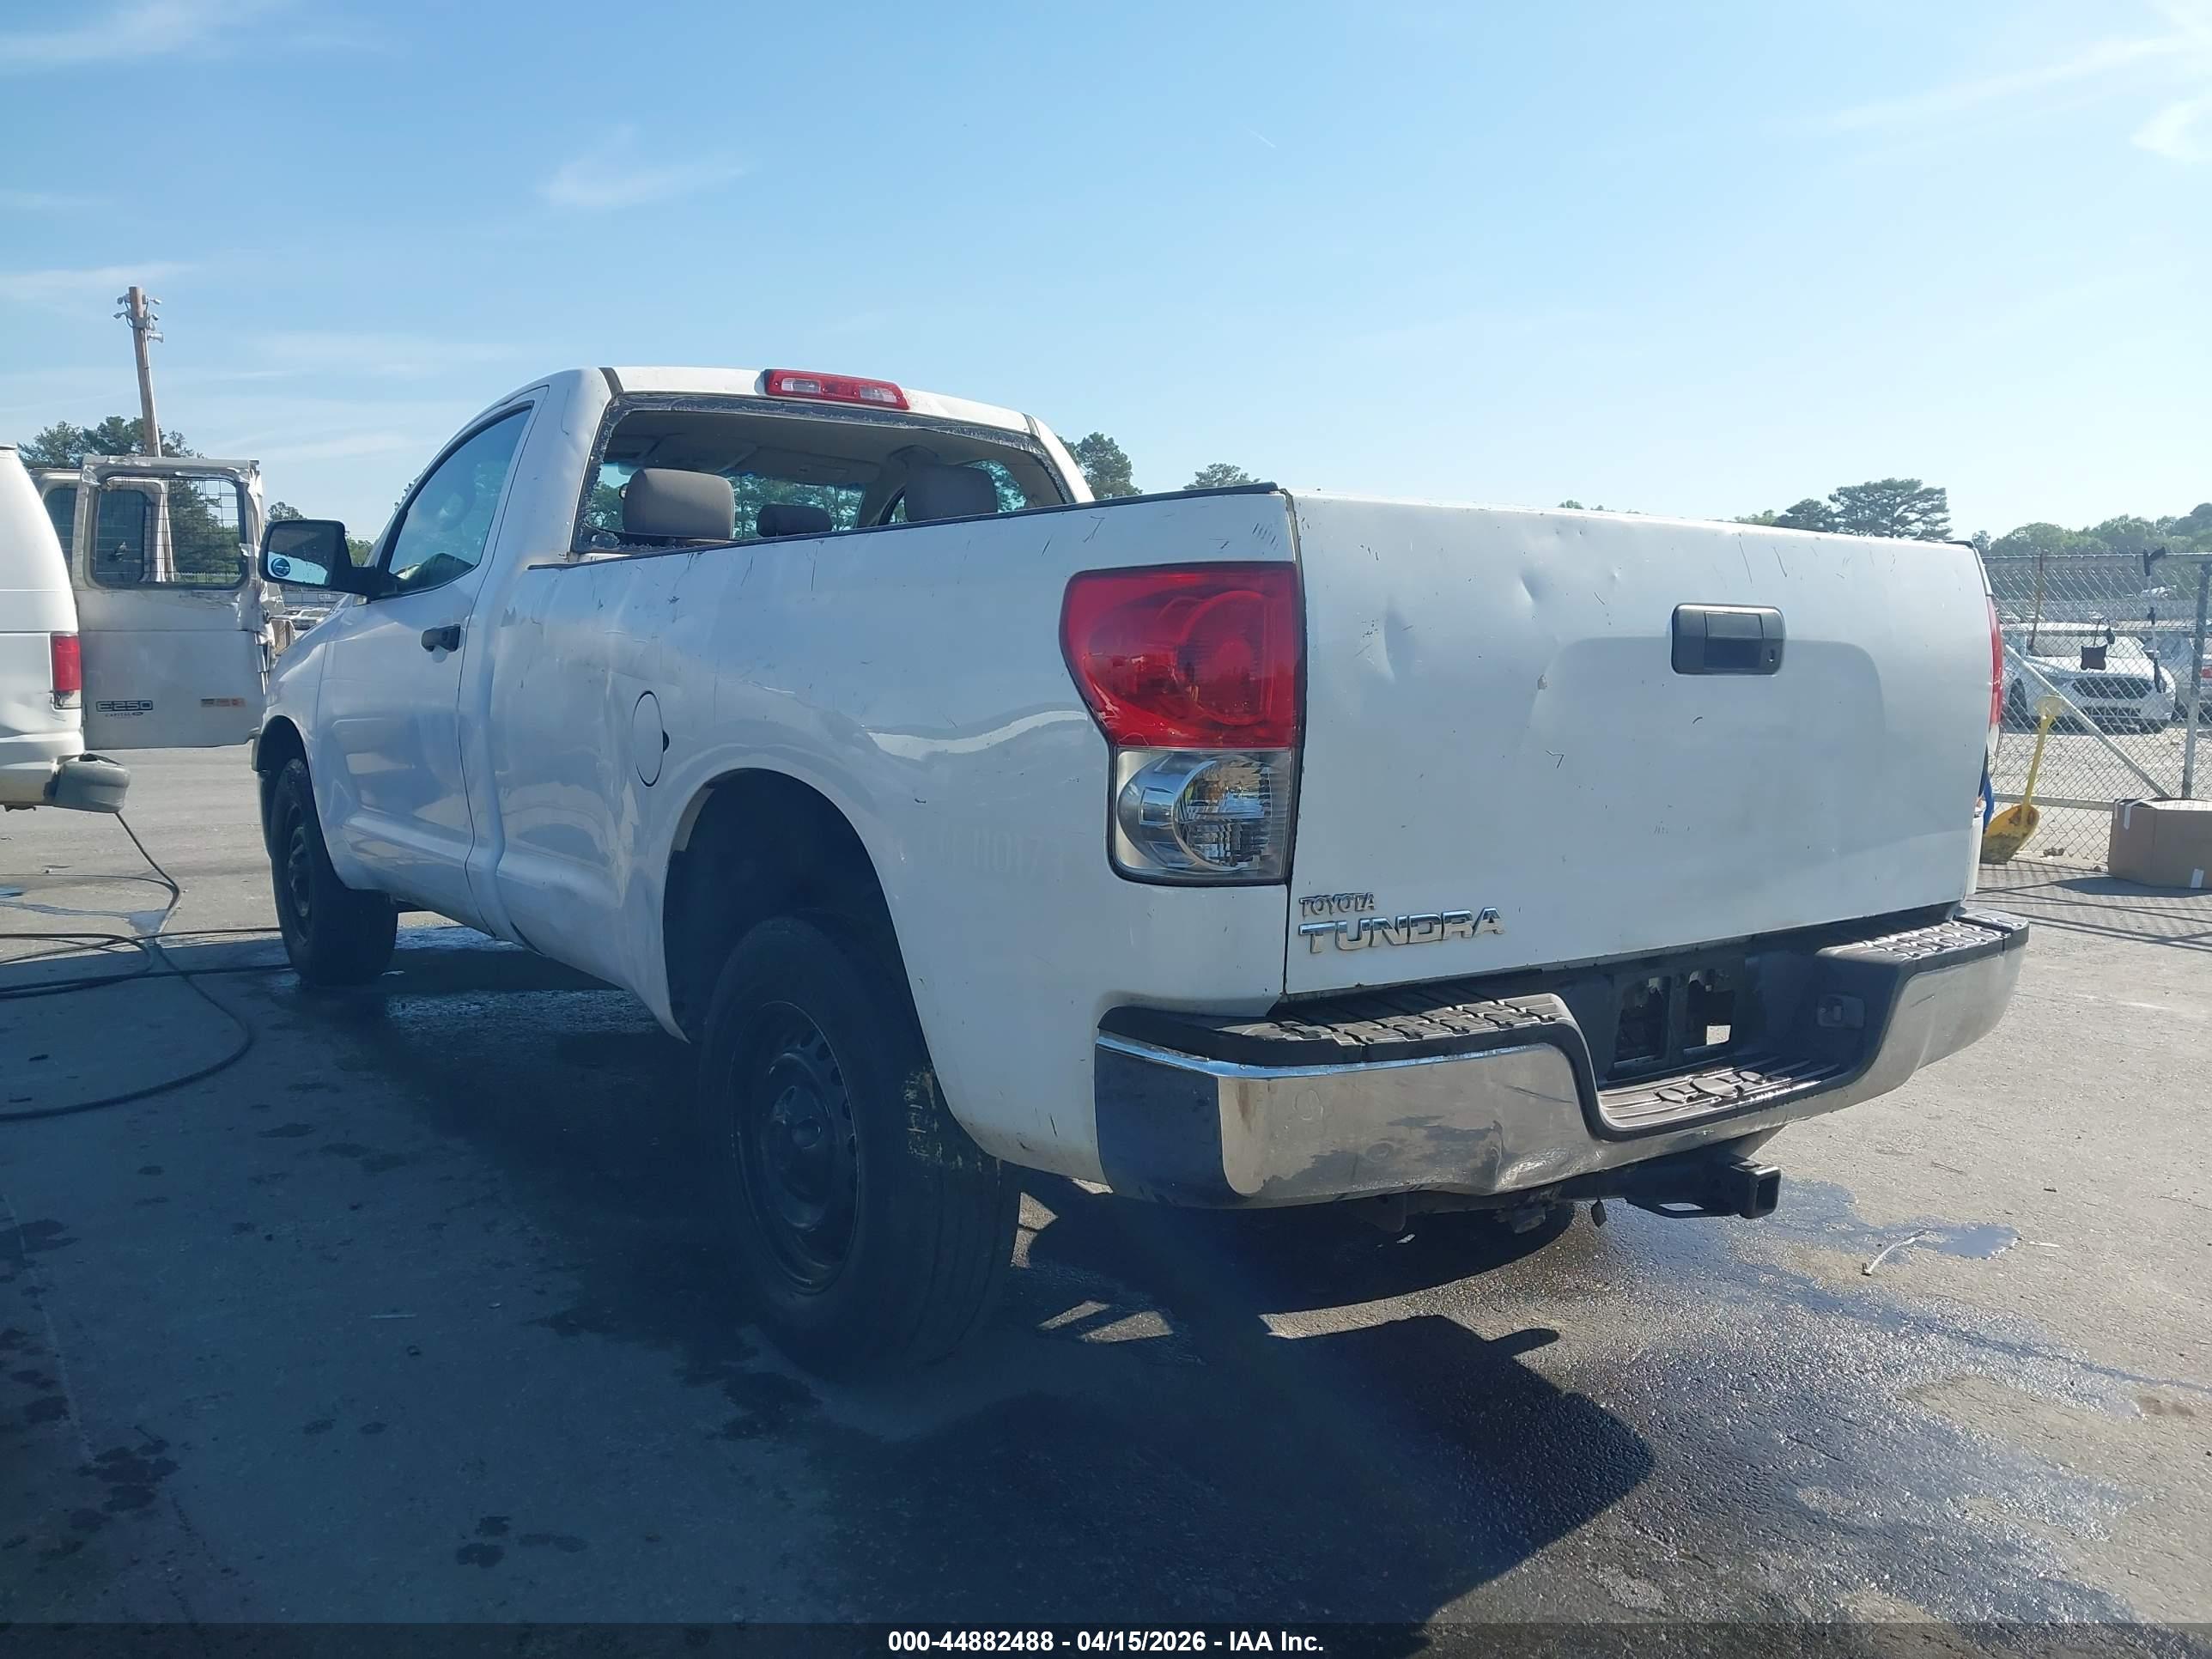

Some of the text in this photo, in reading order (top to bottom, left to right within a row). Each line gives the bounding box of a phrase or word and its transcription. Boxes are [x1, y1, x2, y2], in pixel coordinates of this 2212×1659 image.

[96, 700, 153, 712] E250
[1299, 892, 1375, 917] TOYOTA
[1298, 907, 1505, 954] TUNDRA
